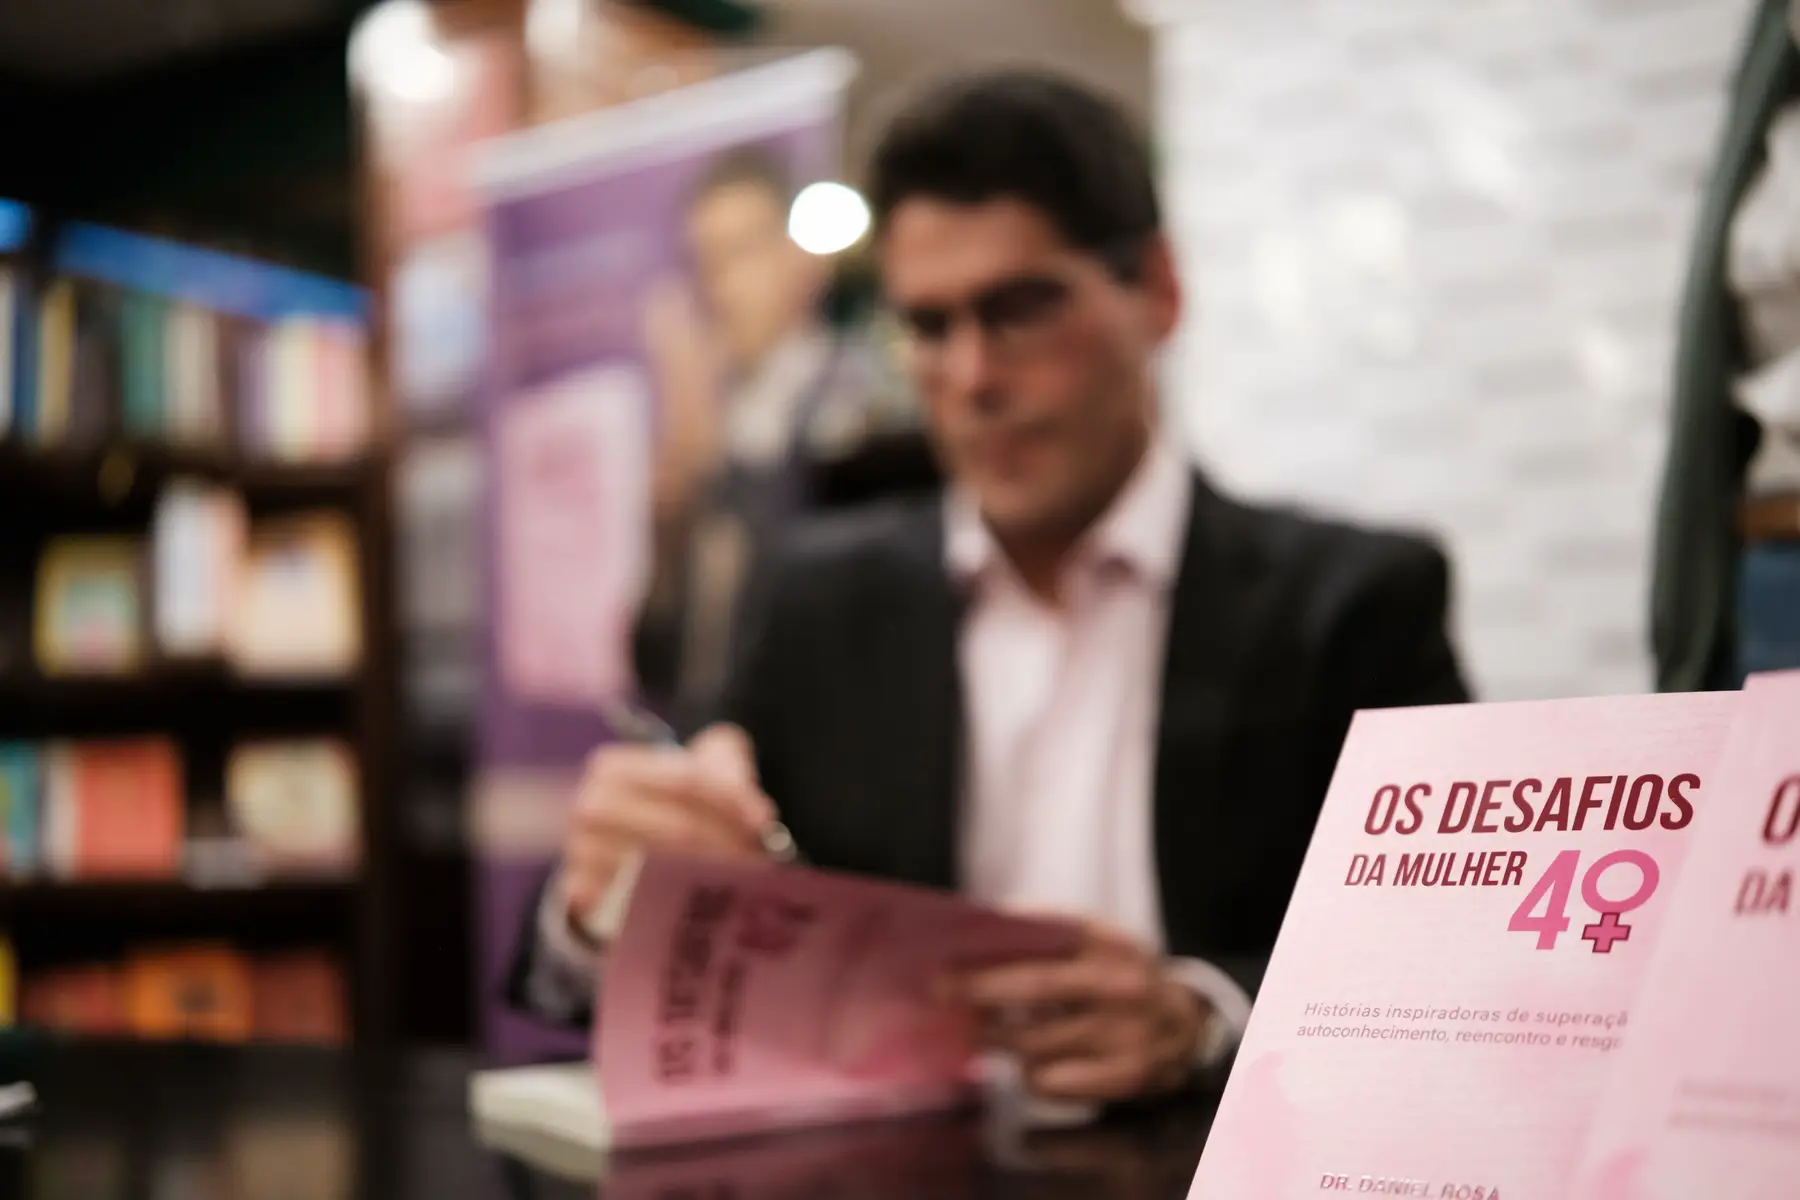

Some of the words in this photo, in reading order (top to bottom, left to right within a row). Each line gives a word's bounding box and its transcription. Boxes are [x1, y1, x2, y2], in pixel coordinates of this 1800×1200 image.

[1364, 783, 1432, 835] OS
[1437, 773, 1701, 834] DESAFIOS
[1344, 854, 1387, 886] DA
[1392, 851, 1528, 886] MULHER
[1735, 869, 1793, 916] DA
[1304, 1002, 1381, 1018] Histórias
[1385, 1004, 1501, 1022] inspiradoras
[1506, 1007, 1530, 1023] de
[1297, 1024, 1450, 1043] autoconhecimento,
[1455, 1030, 1551, 1046] reencontro
[1556, 1034, 1567, 1046] e
[1320, 1172, 1352, 1191] DR.
[1358, 1176, 1434, 1198] DANIEL
[1440, 1182, 1501, 1200] ROSA
